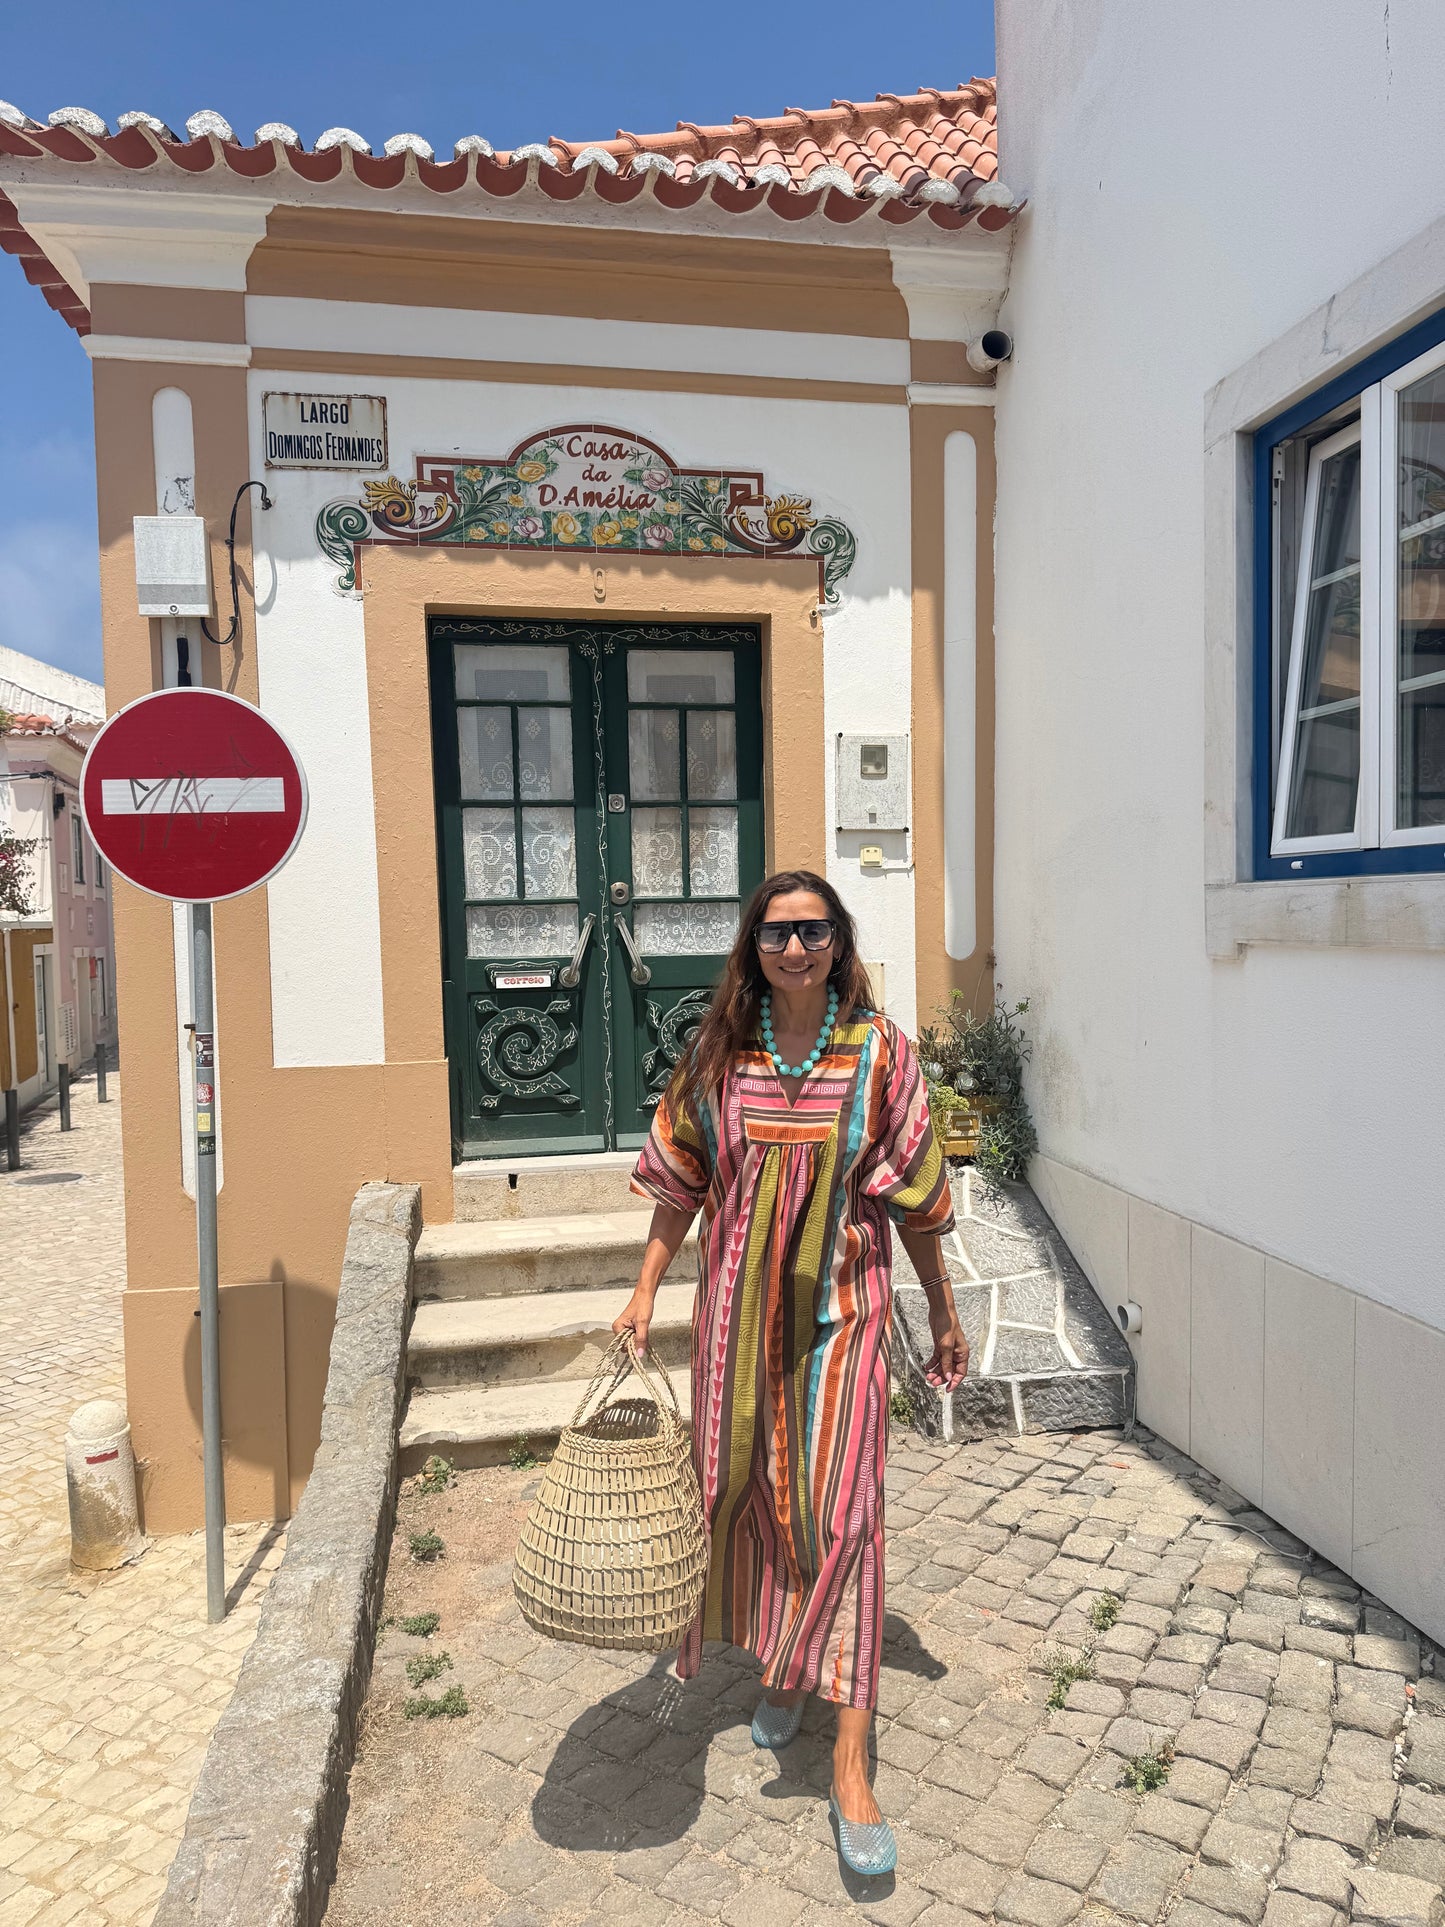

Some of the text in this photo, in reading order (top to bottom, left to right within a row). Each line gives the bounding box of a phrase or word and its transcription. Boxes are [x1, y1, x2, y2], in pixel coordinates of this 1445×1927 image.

[301, 402, 349, 424] LARGO
[269, 432, 383, 463] DOMINGOS FERNANDES
[566, 434, 630, 461] Casa
[582, 463, 612, 482] da
[504, 976, 545, 985] correio
